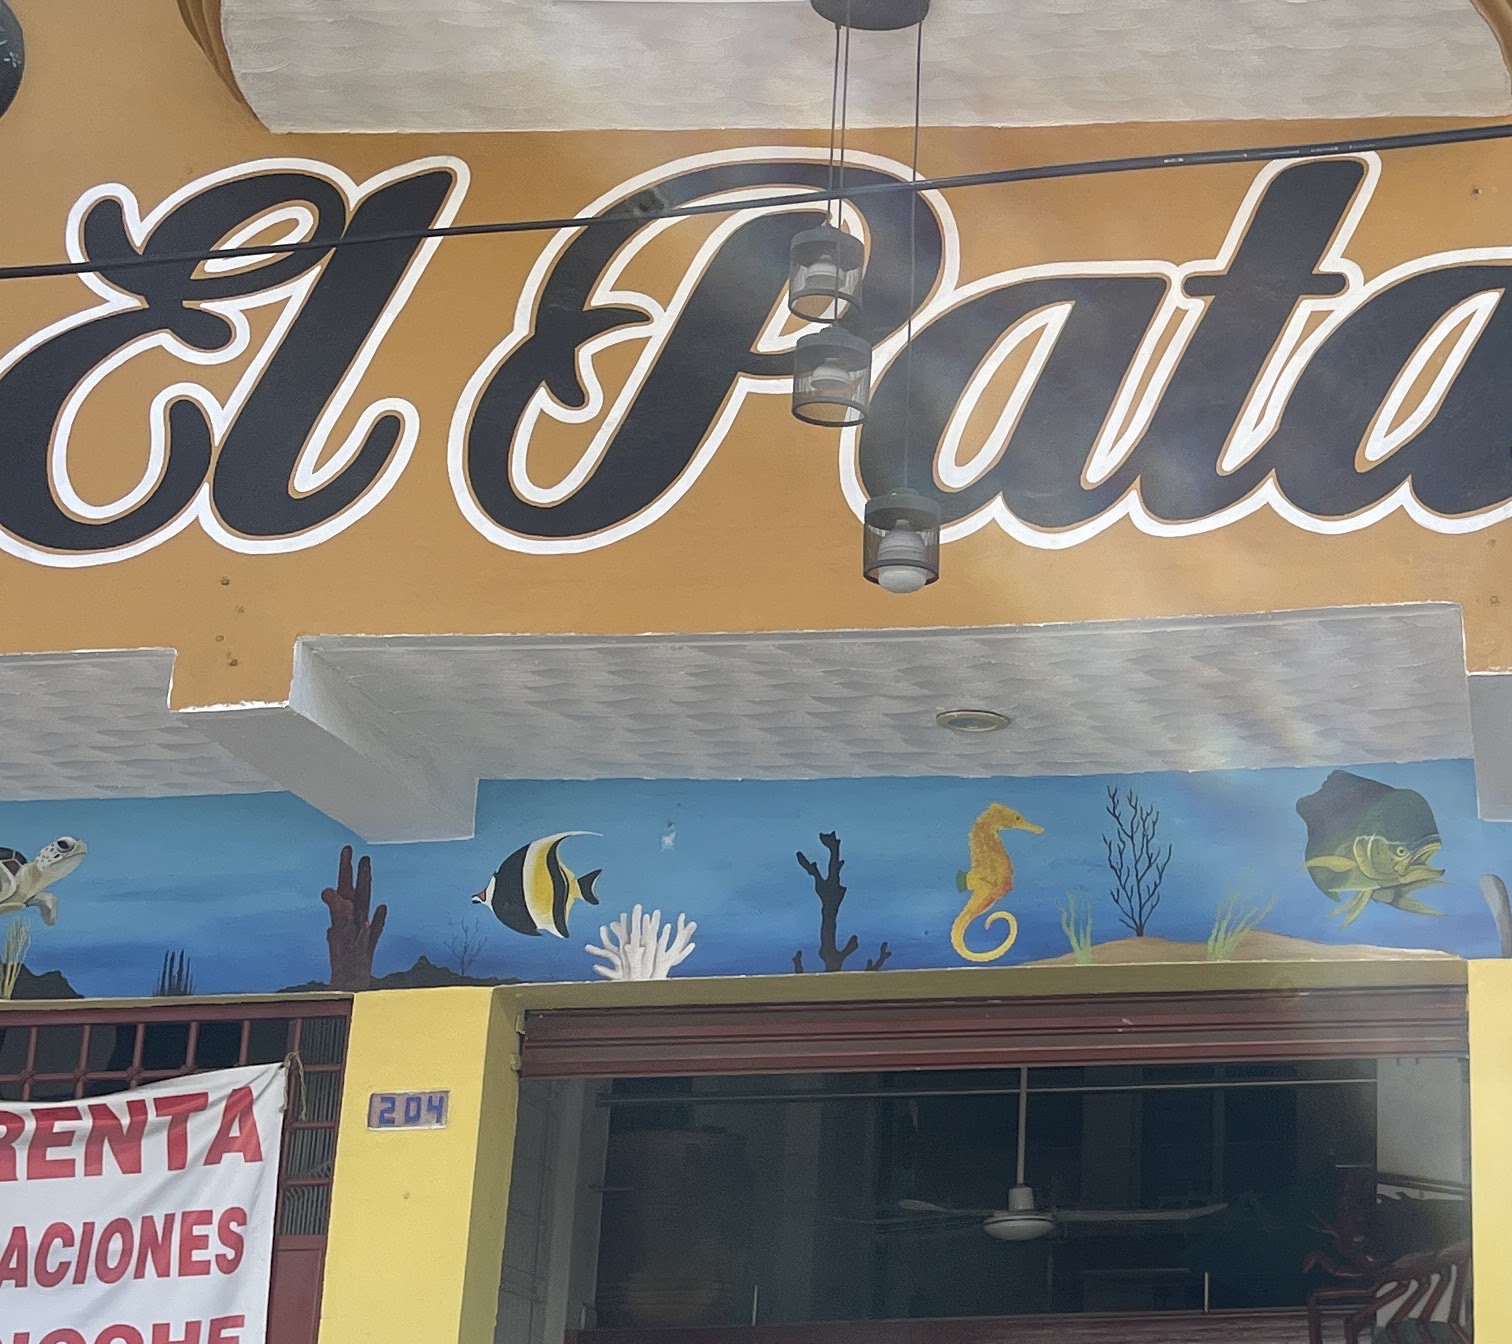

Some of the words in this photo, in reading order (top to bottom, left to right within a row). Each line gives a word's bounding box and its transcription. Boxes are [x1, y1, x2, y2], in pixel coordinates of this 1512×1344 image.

[0, 156, 470, 567] El
[378, 1094, 445, 1125] 204
[0, 1206, 248, 1288] ACIONES
